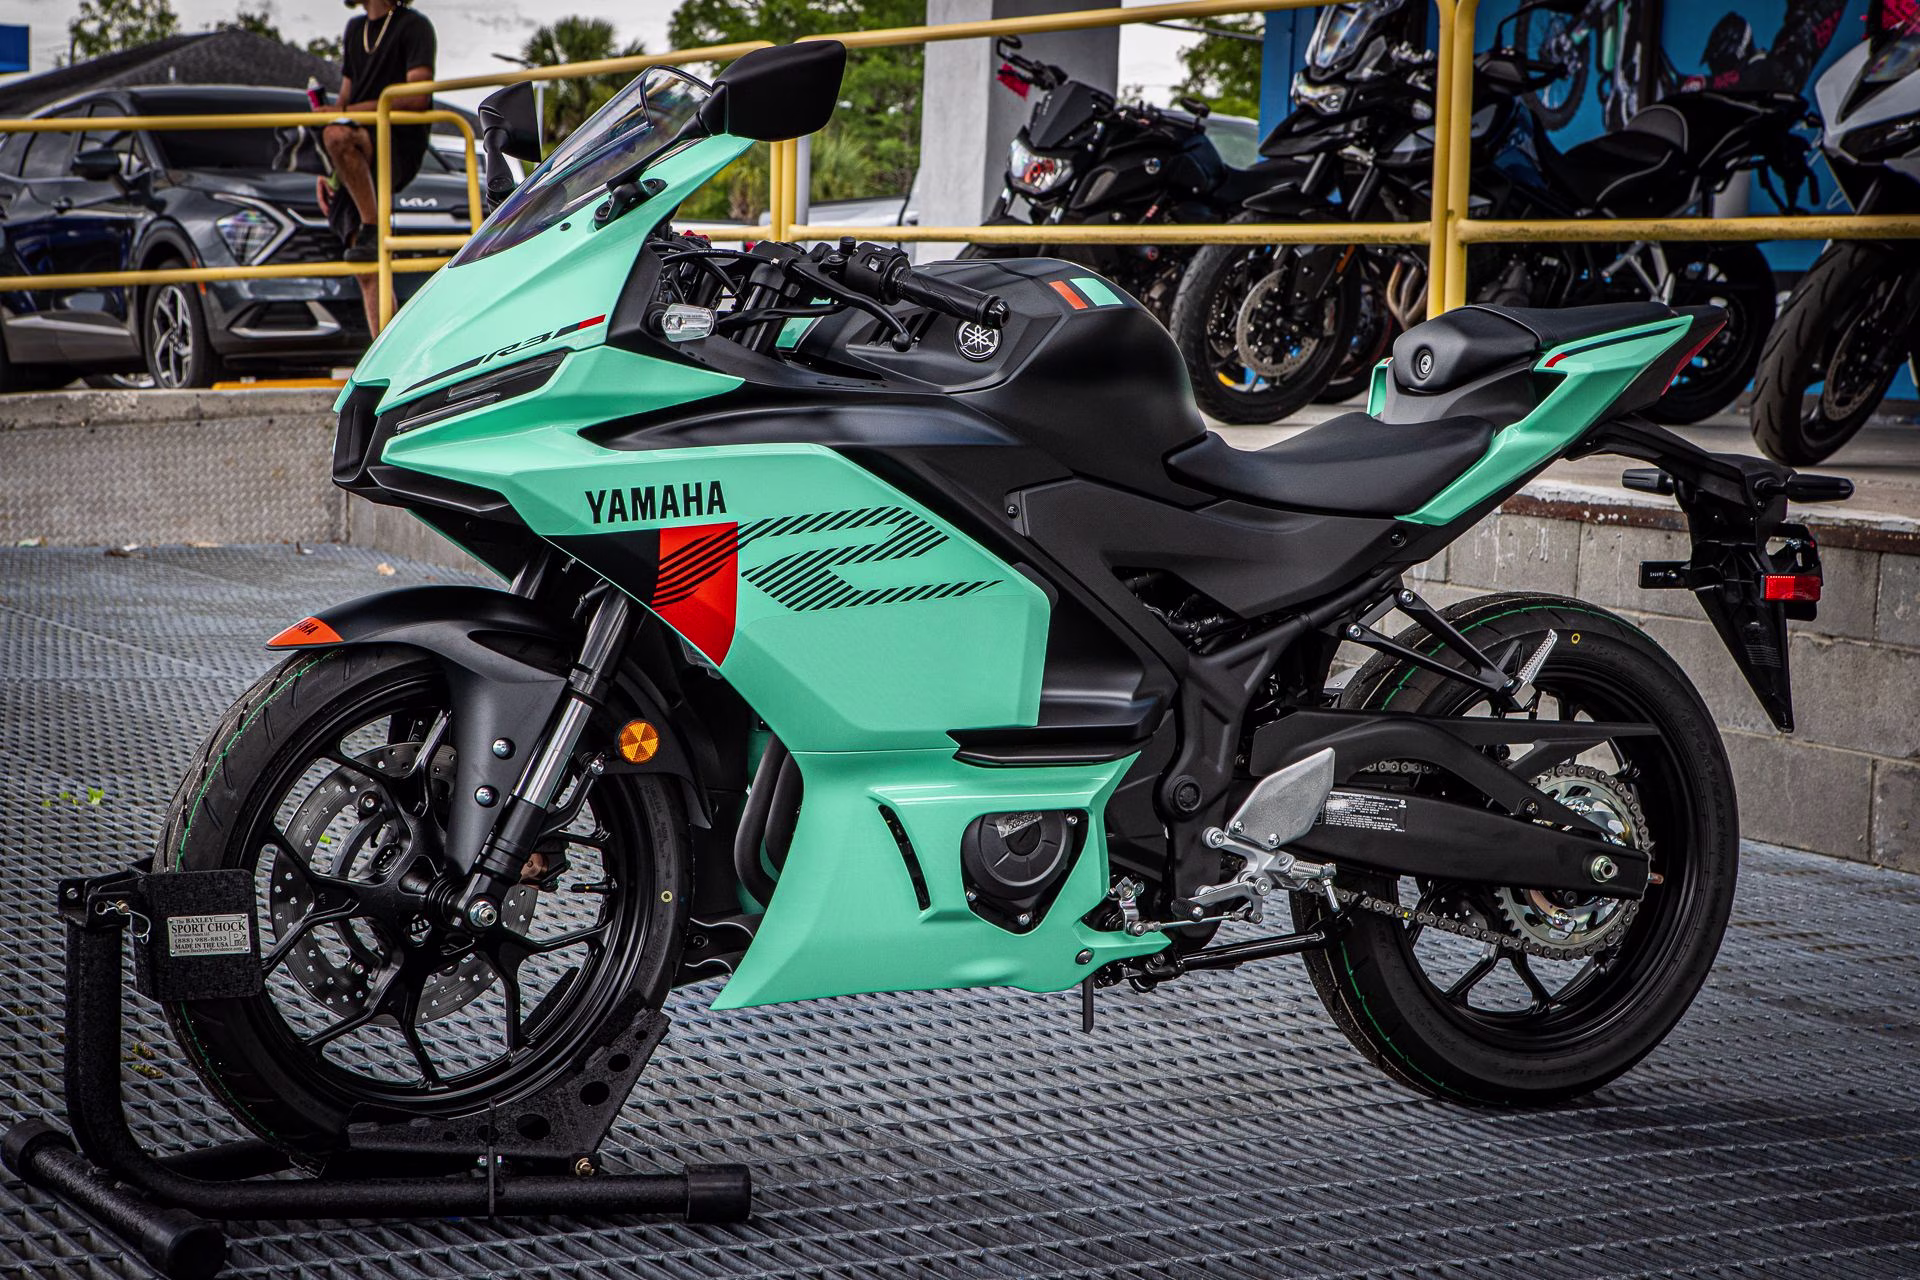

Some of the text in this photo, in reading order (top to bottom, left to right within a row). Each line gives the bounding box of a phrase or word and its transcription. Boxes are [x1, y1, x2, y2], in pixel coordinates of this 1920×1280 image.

[584, 480, 727, 524] YAMAHA
[172, 921, 247, 933] SPORT CHOCK
